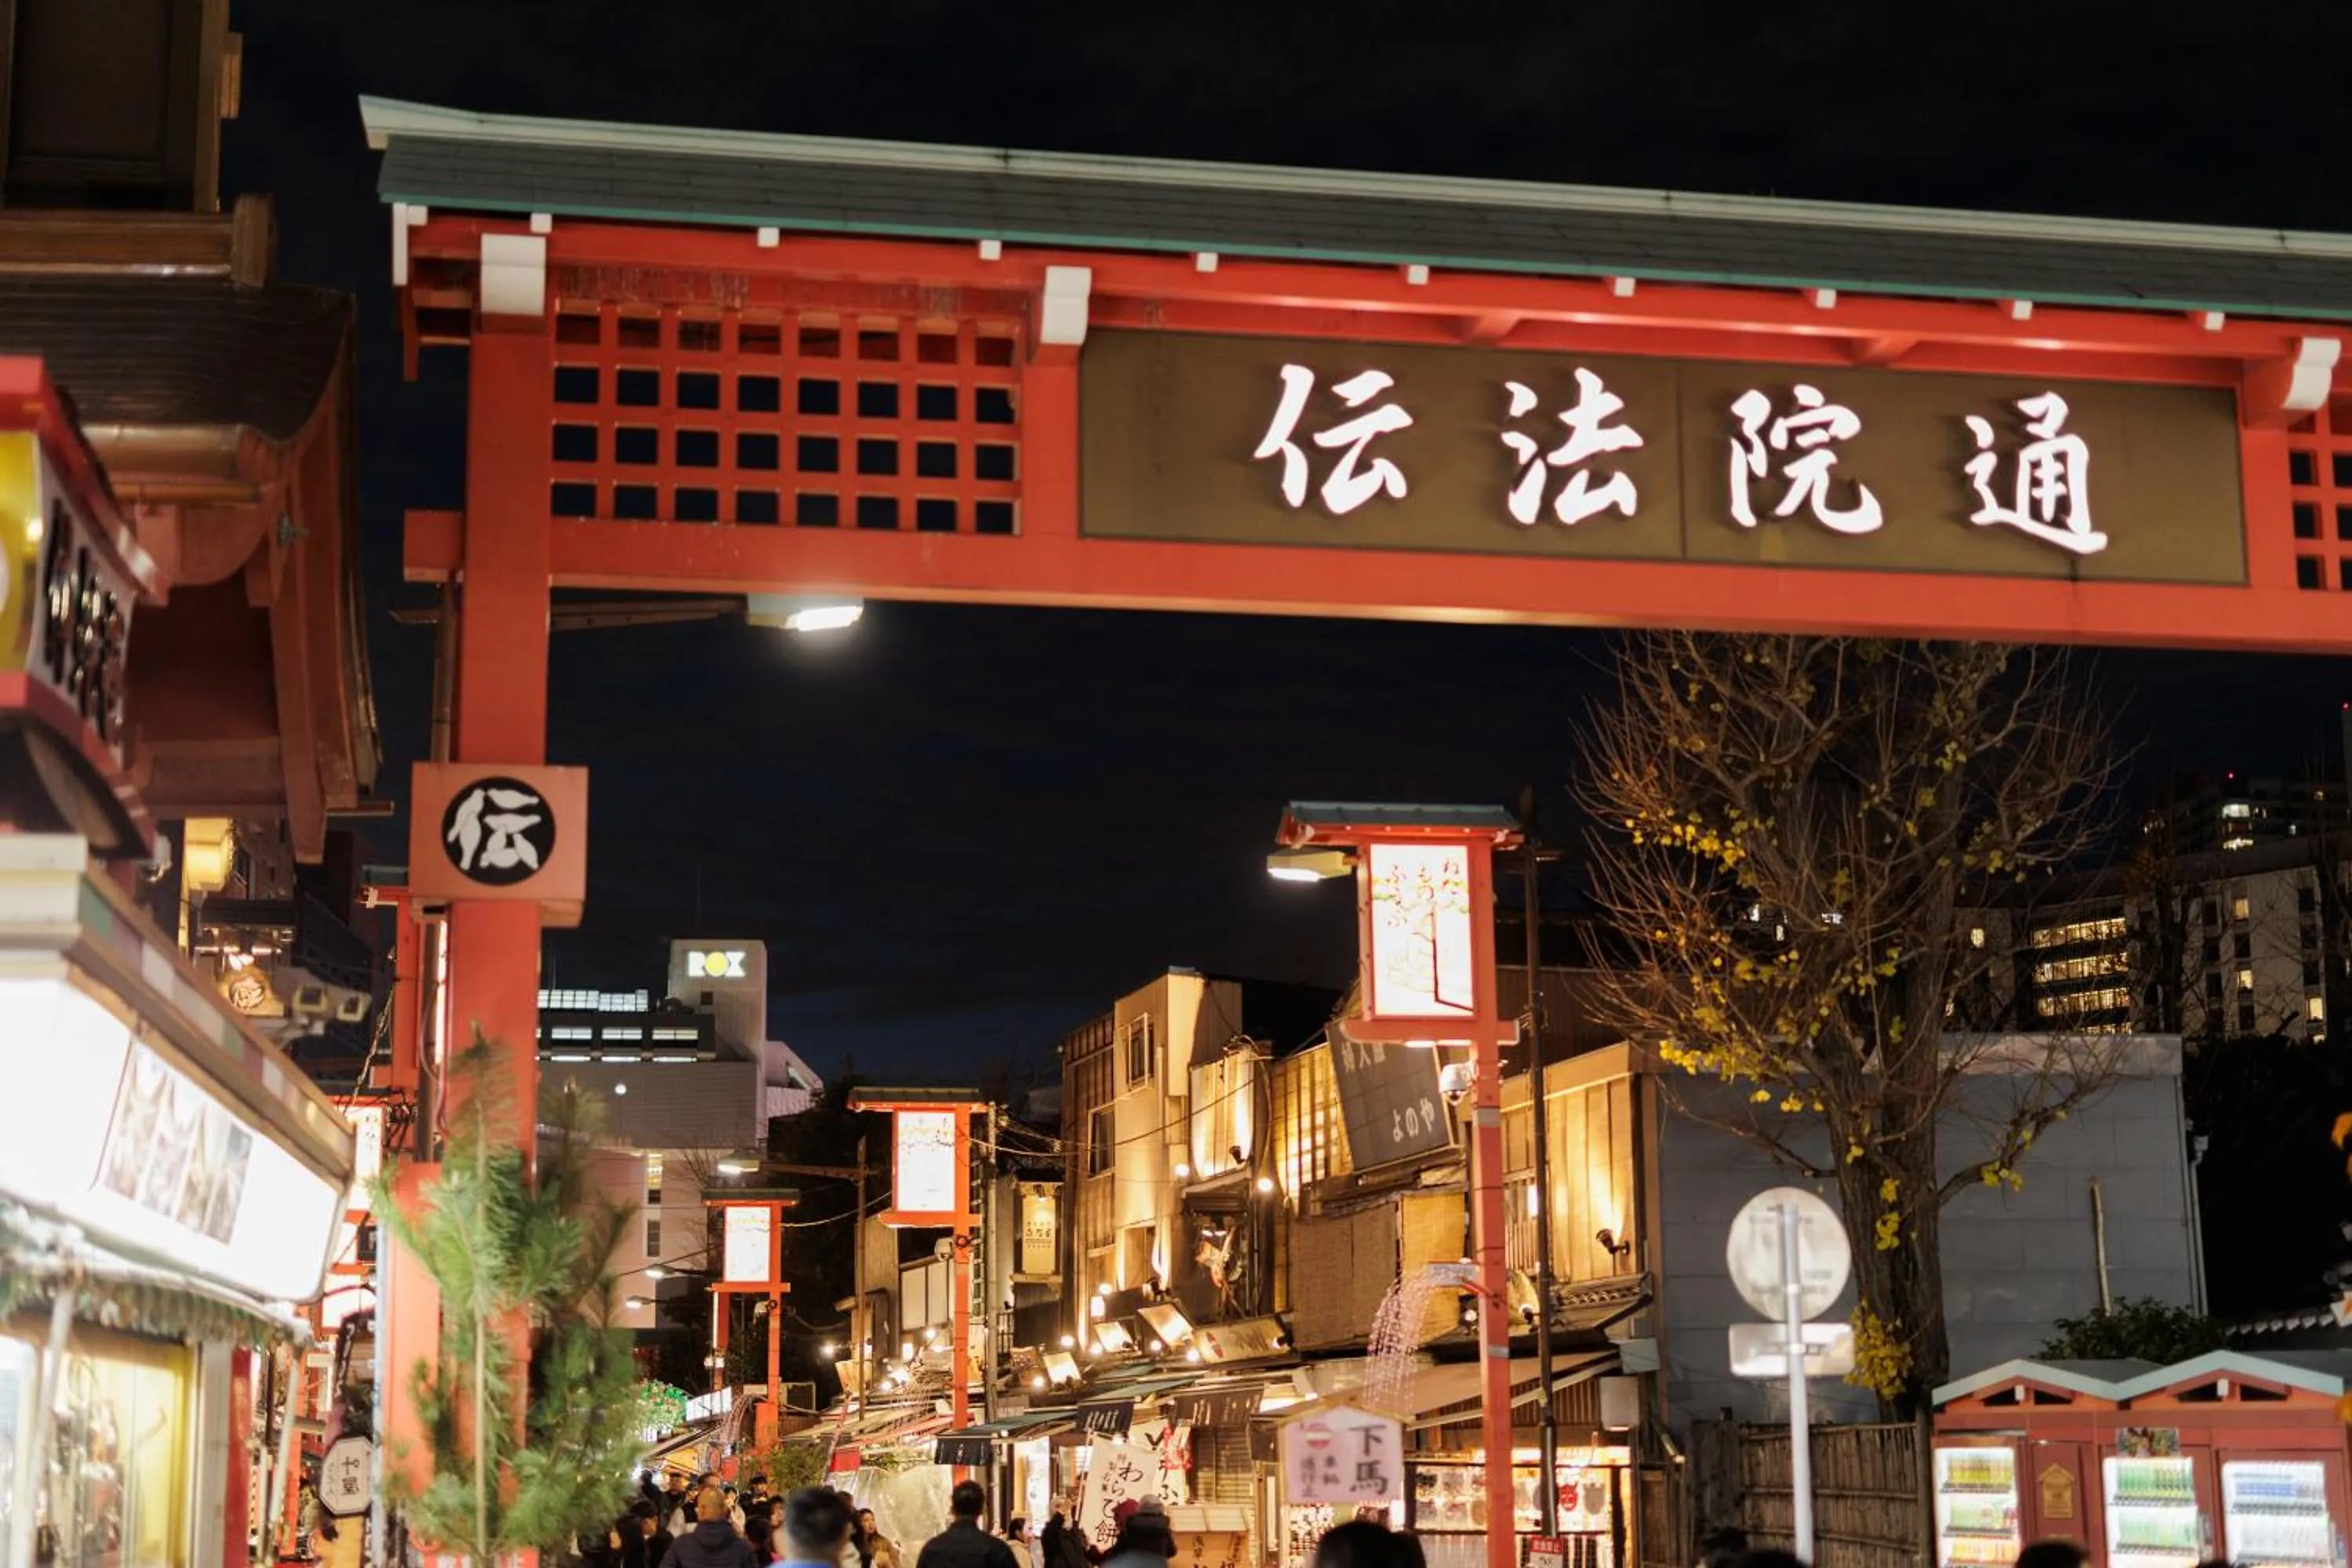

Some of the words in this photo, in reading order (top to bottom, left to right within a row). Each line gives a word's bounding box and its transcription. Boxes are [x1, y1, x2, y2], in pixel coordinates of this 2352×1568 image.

[1253, 363, 2108, 554] 伝法院通
[447, 788, 541, 869] 伝
[688, 950, 746, 978] ROX
[1392, 1097, 1436, 1143] よのや
[1348, 1424, 1389, 1495] 下馬
